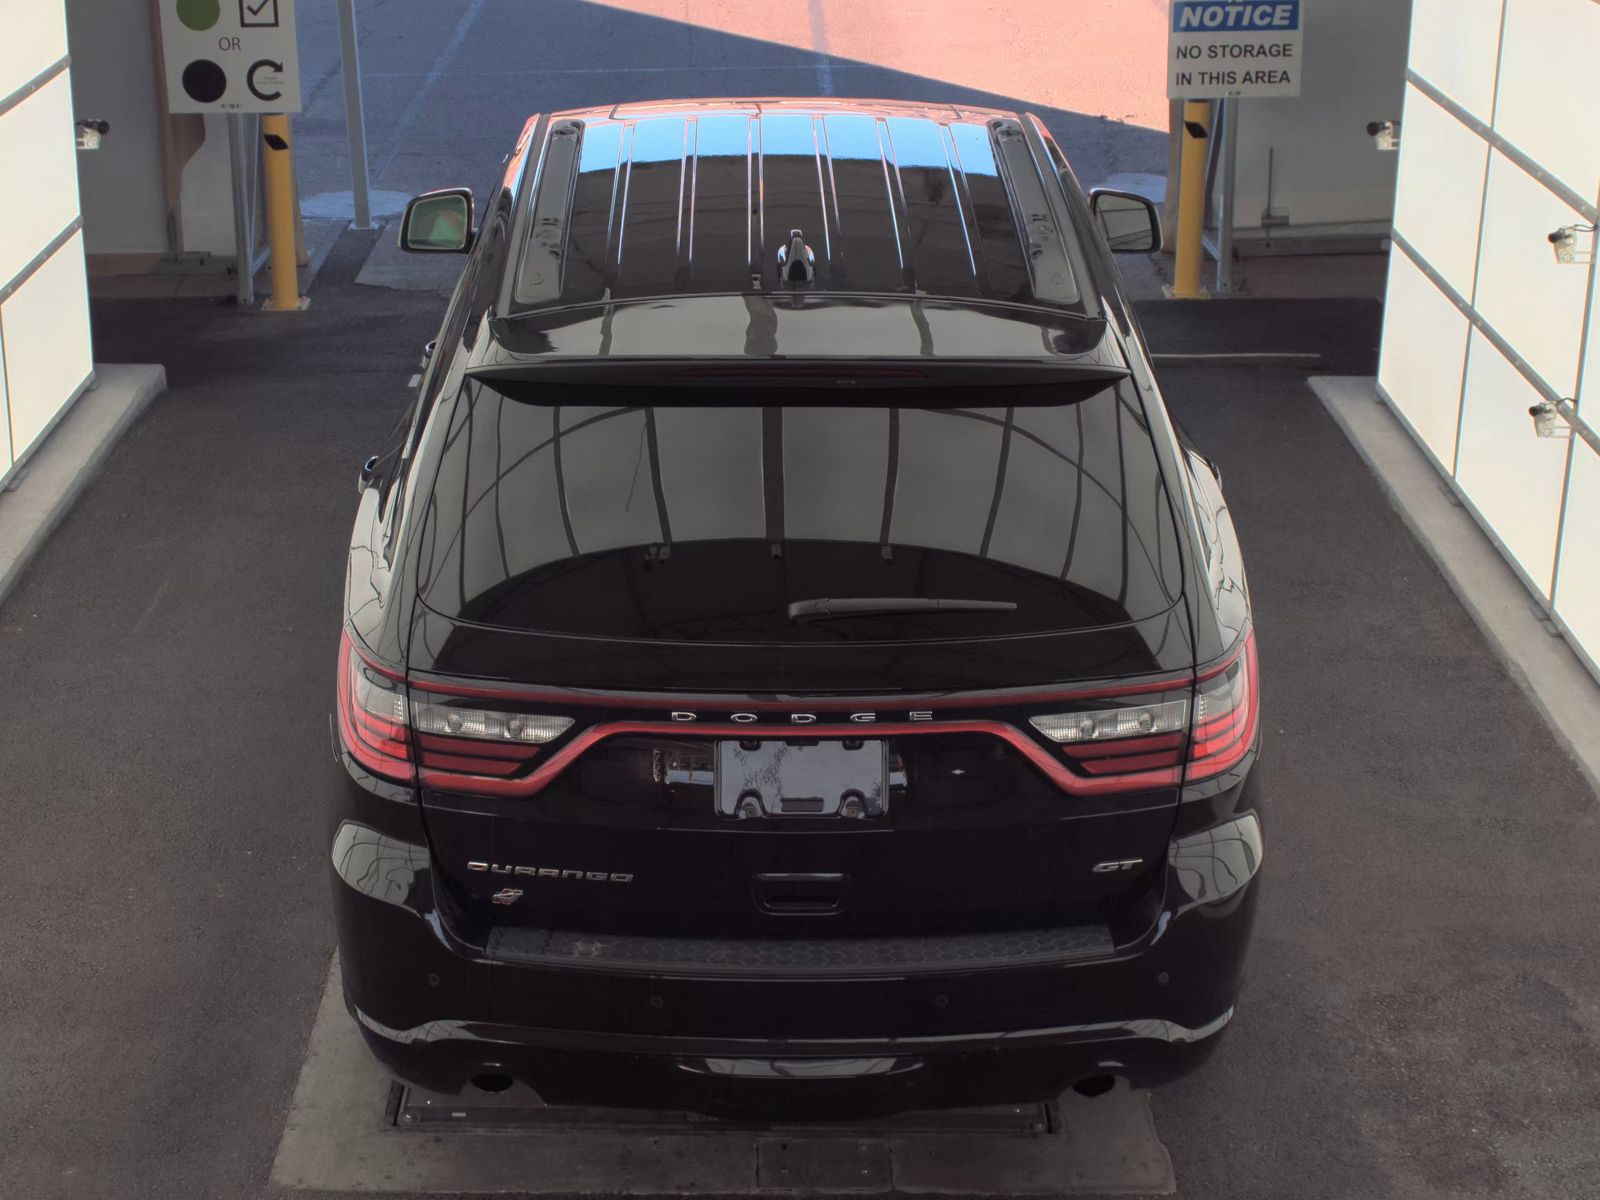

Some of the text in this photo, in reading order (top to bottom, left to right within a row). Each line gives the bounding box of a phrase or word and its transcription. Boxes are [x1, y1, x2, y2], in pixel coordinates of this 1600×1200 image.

[1180, 4, 1293, 27] NOTICE
[218, 37, 241, 51] OR
[1176, 43, 1293, 59] NO STORAGE
[1176, 70, 1291, 86] IN THIS AREA
[671, 711, 934, 723] DODGE
[467, 861, 634, 882] DURANGO
[1093, 859, 1143, 873] GT
